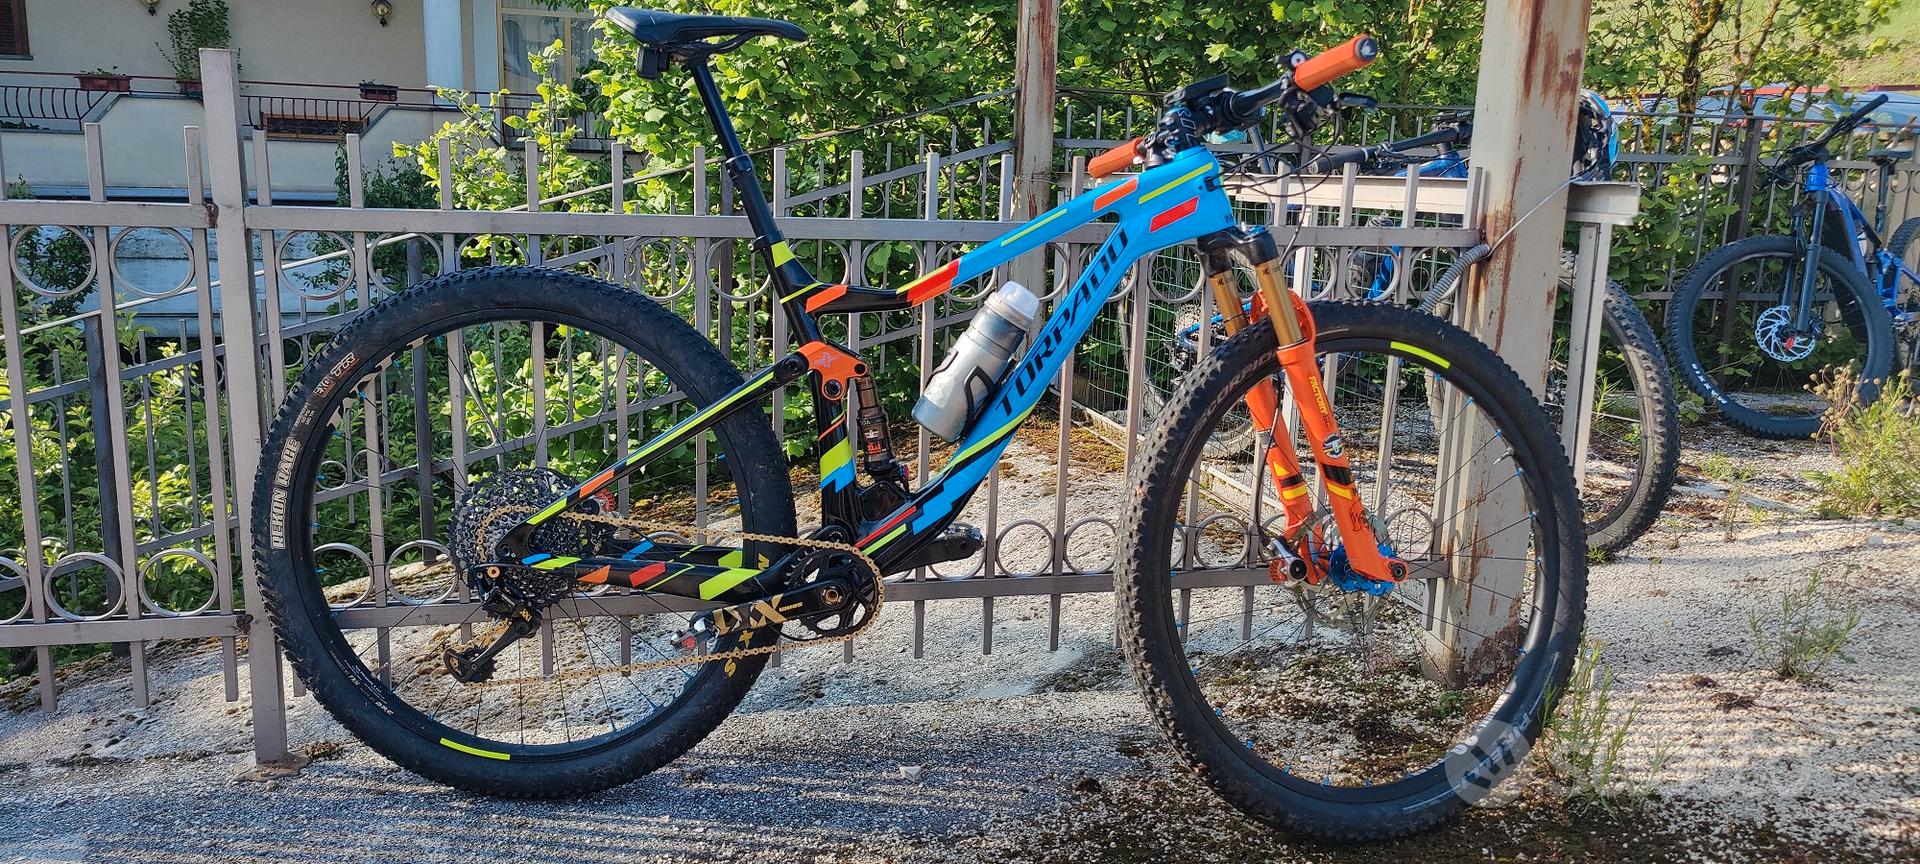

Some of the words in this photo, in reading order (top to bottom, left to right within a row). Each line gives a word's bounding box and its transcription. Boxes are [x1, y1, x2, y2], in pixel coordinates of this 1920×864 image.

[995, 228, 1129, 417] TORPADO
[1308, 375, 1329, 415] FACTORY
[274, 436, 301, 488] RACE
[270, 487, 288, 550] REKON
